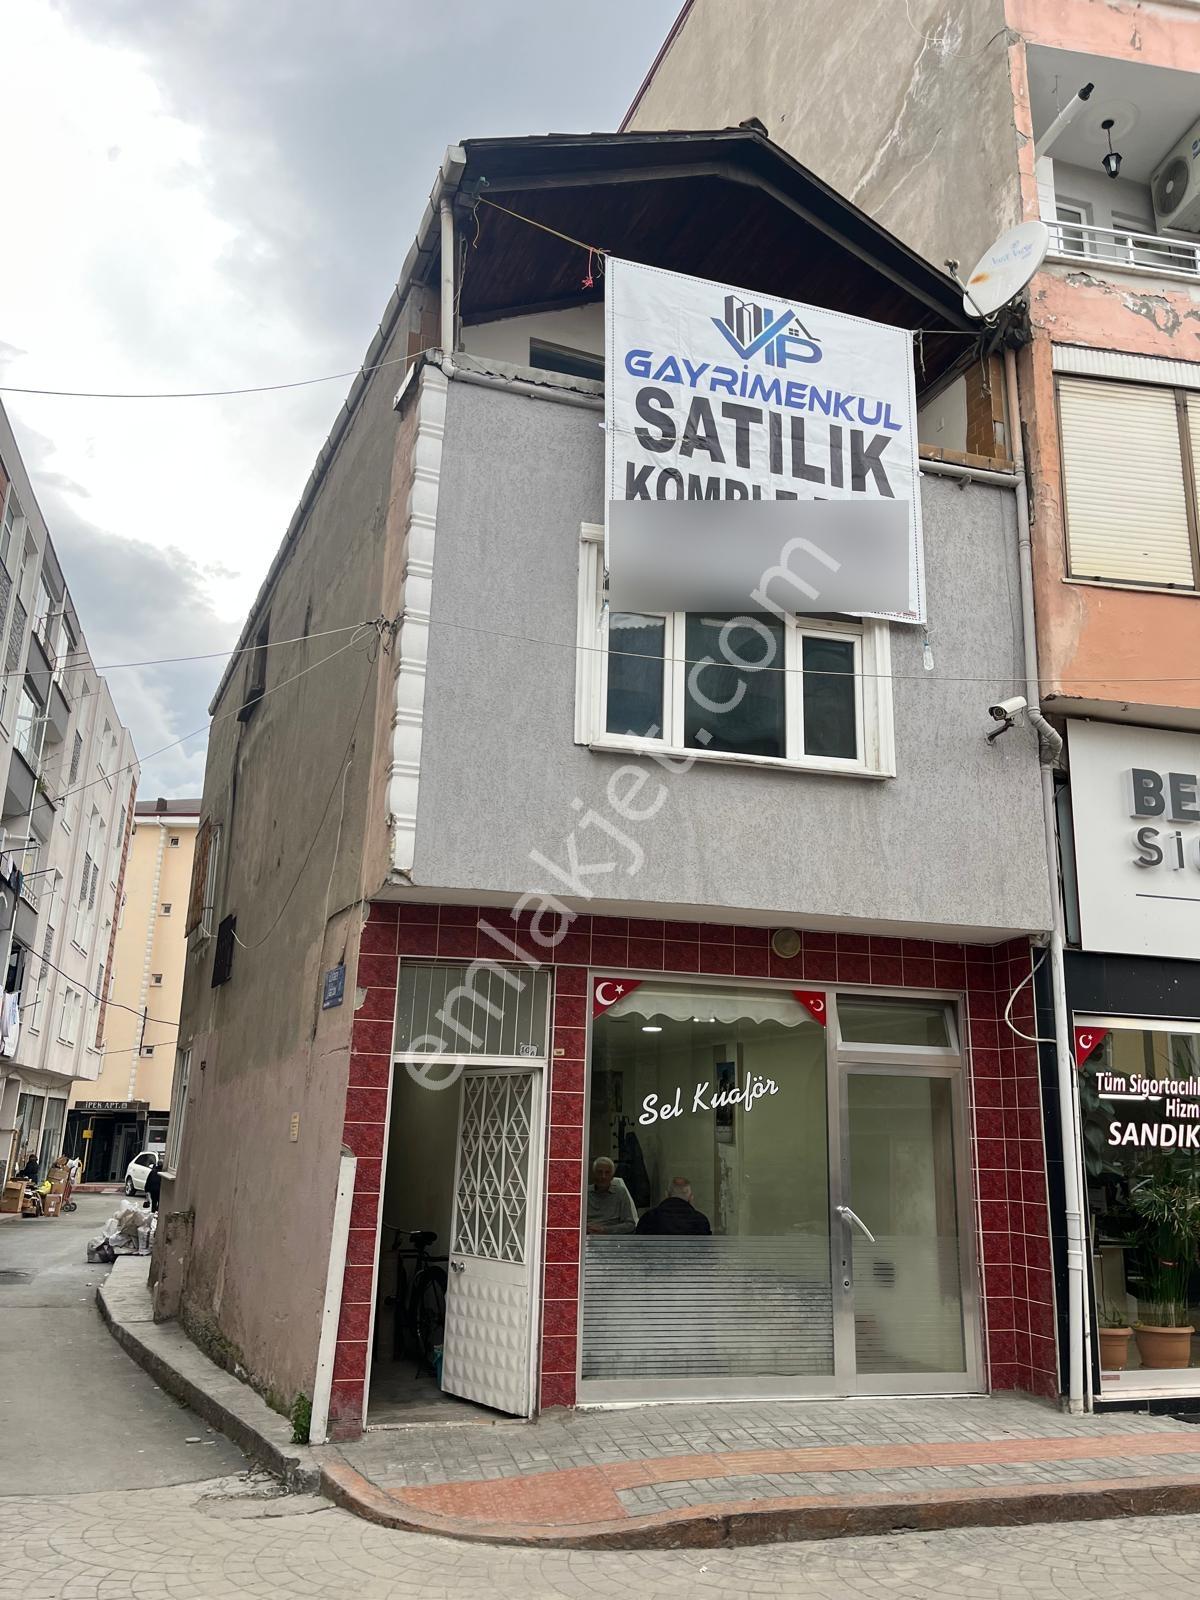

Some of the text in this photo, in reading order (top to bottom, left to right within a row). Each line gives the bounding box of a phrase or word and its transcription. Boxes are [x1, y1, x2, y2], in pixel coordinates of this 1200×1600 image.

[711, 308, 823, 369] VIP
[624, 349, 903, 431] GAYRİMENKUL
[634, 386, 895, 499] SATILIK
[638, 1071, 779, 1126] Sel Kuaför
[1095, 1072, 1126, 1091] Tüm
[1165, 1098, 1200, 1118] Hizm
[1108, 1121, 1200, 1148] SANDIK
